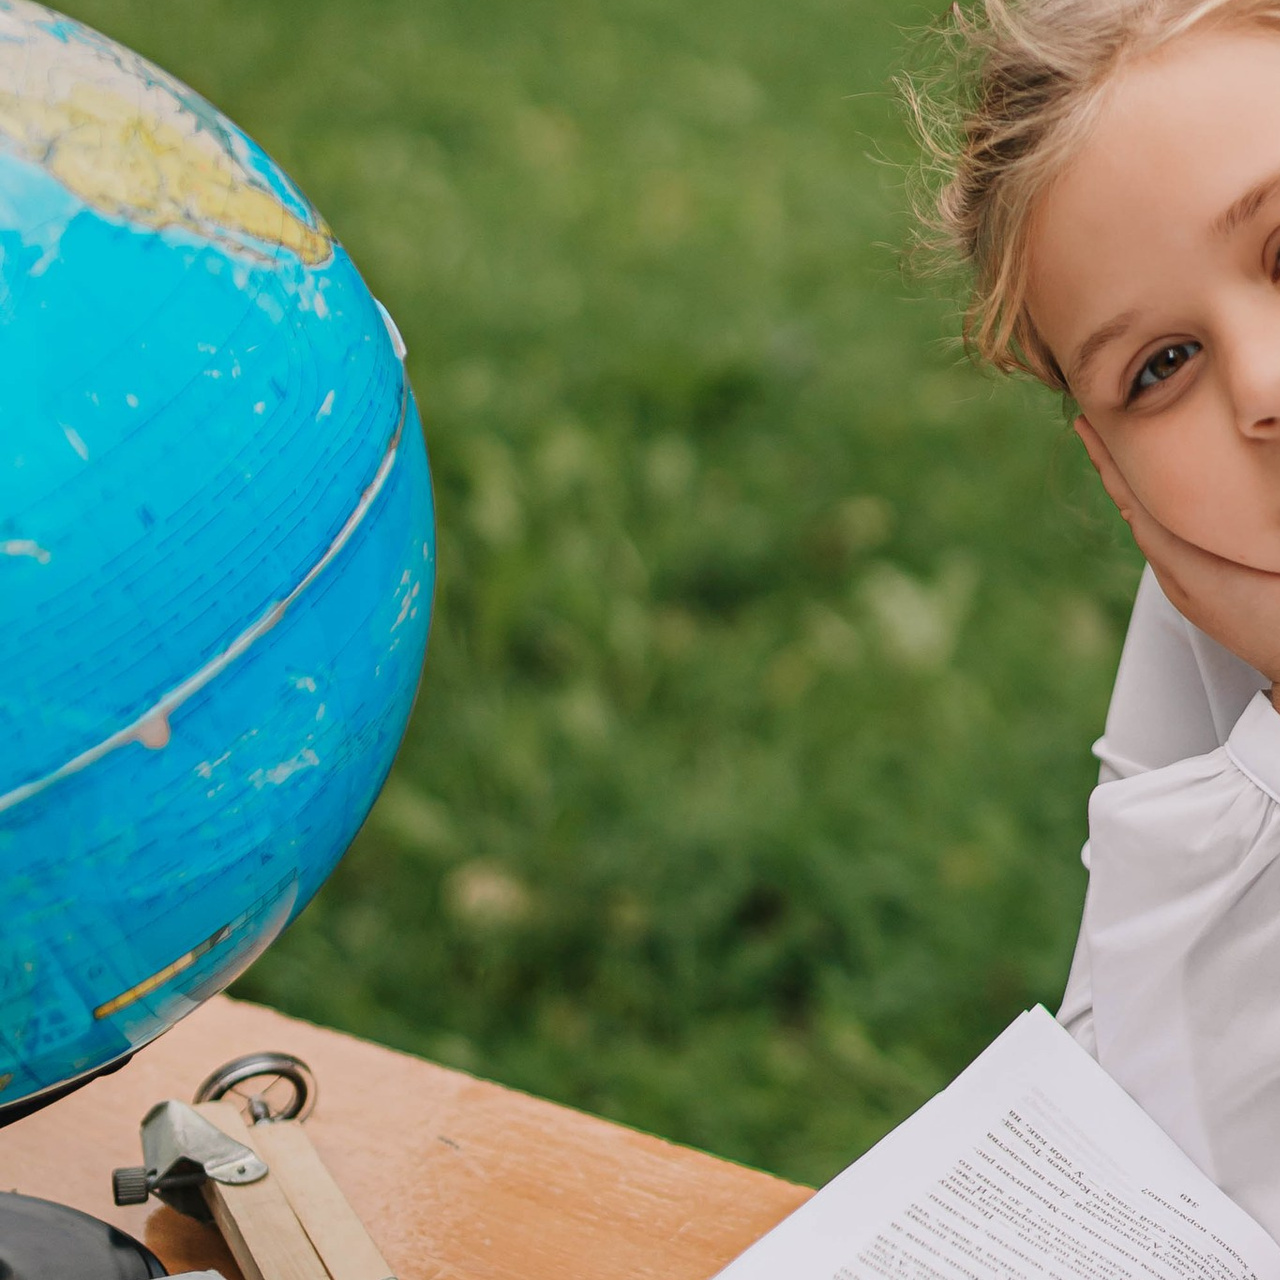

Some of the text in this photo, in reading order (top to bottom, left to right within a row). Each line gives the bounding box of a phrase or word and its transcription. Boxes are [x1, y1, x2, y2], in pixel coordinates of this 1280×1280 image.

[1008, 1109, 1023, 1124] на
[1001, 1118, 1024, 1139] под-
[1026, 1126, 1048, 1147] как,
[986, 1131, 1046, 1181] начальства
[1022, 1138, 1042, 1158] Тот
[1048, 1146, 1073, 1169] тебя
[1045, 1154, 1092, 1195] Китенев.
[995, 1164, 1060, 1214] Макарихин
[1046, 1180, 1072, 1200] Для
[1091, 1192, 1111, 1207] его
[1103, 1188, 1137, 1215] глаза.
[1140, 1187, 1208, 1234] нормально?
[1179, 1193, 1200, 1209] 349
[1060, 1211, 1076, 1223] но
[1085, 1200, 1127, 1227] семьи?
[1138, 1214, 1167, 1234] едой
[1078, 1221, 1139, 1264] известная,
[1128, 1226, 1153, 1242] для
[1151, 1250, 1186, 1277] какой
[1163, 1251, 1196, 1274] себя?
[1210, 1233, 1250, 1271] ходишь
